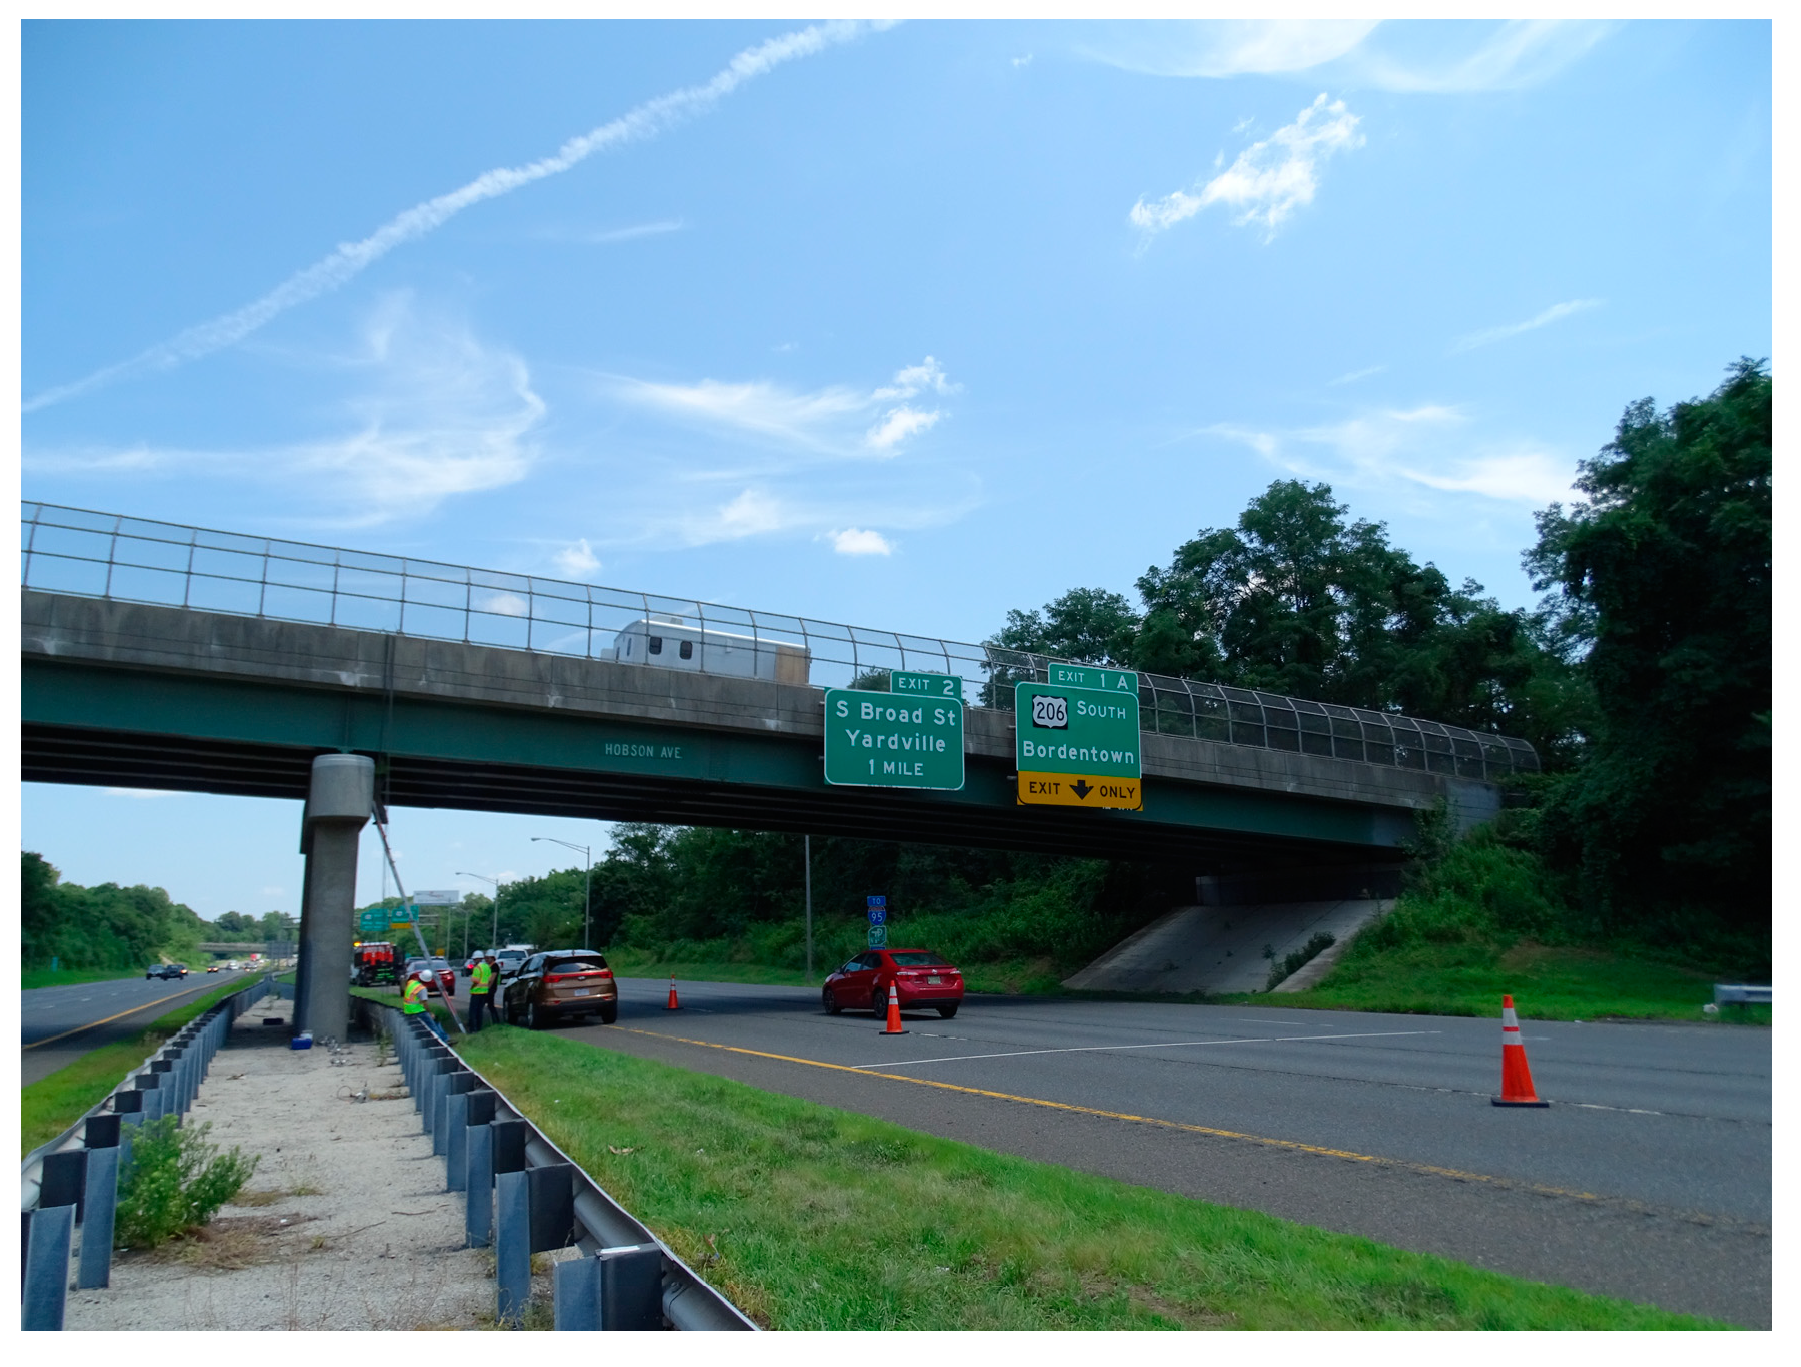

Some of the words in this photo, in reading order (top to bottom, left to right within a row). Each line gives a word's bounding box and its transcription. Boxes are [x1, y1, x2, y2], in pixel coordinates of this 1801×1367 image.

[898, 677, 929, 690] EXIT
[943, 680, 954, 696] 2
[1058, 670, 1084, 683] EXIT
[1100, 674, 1106, 688] 1
[1117, 675, 1129, 690] A
[836, 700, 849, 718] S
[860, 702, 922, 724] Broad
[934, 708, 956, 726] St
[1036, 701, 1065, 722] 206
[845, 729, 946, 752] Yardville
[605, 744, 654, 757] HOBSON
[660, 747, 682, 758] AVE
[1022, 741, 1134, 765] Bordentown
[868, 759, 874, 775] 1
[884, 760, 924, 776] MILE
[1029, 781, 1061, 795] EXIT
[1100, 784, 1136, 799] ONLY
[872, 912, 882, 922] 95
